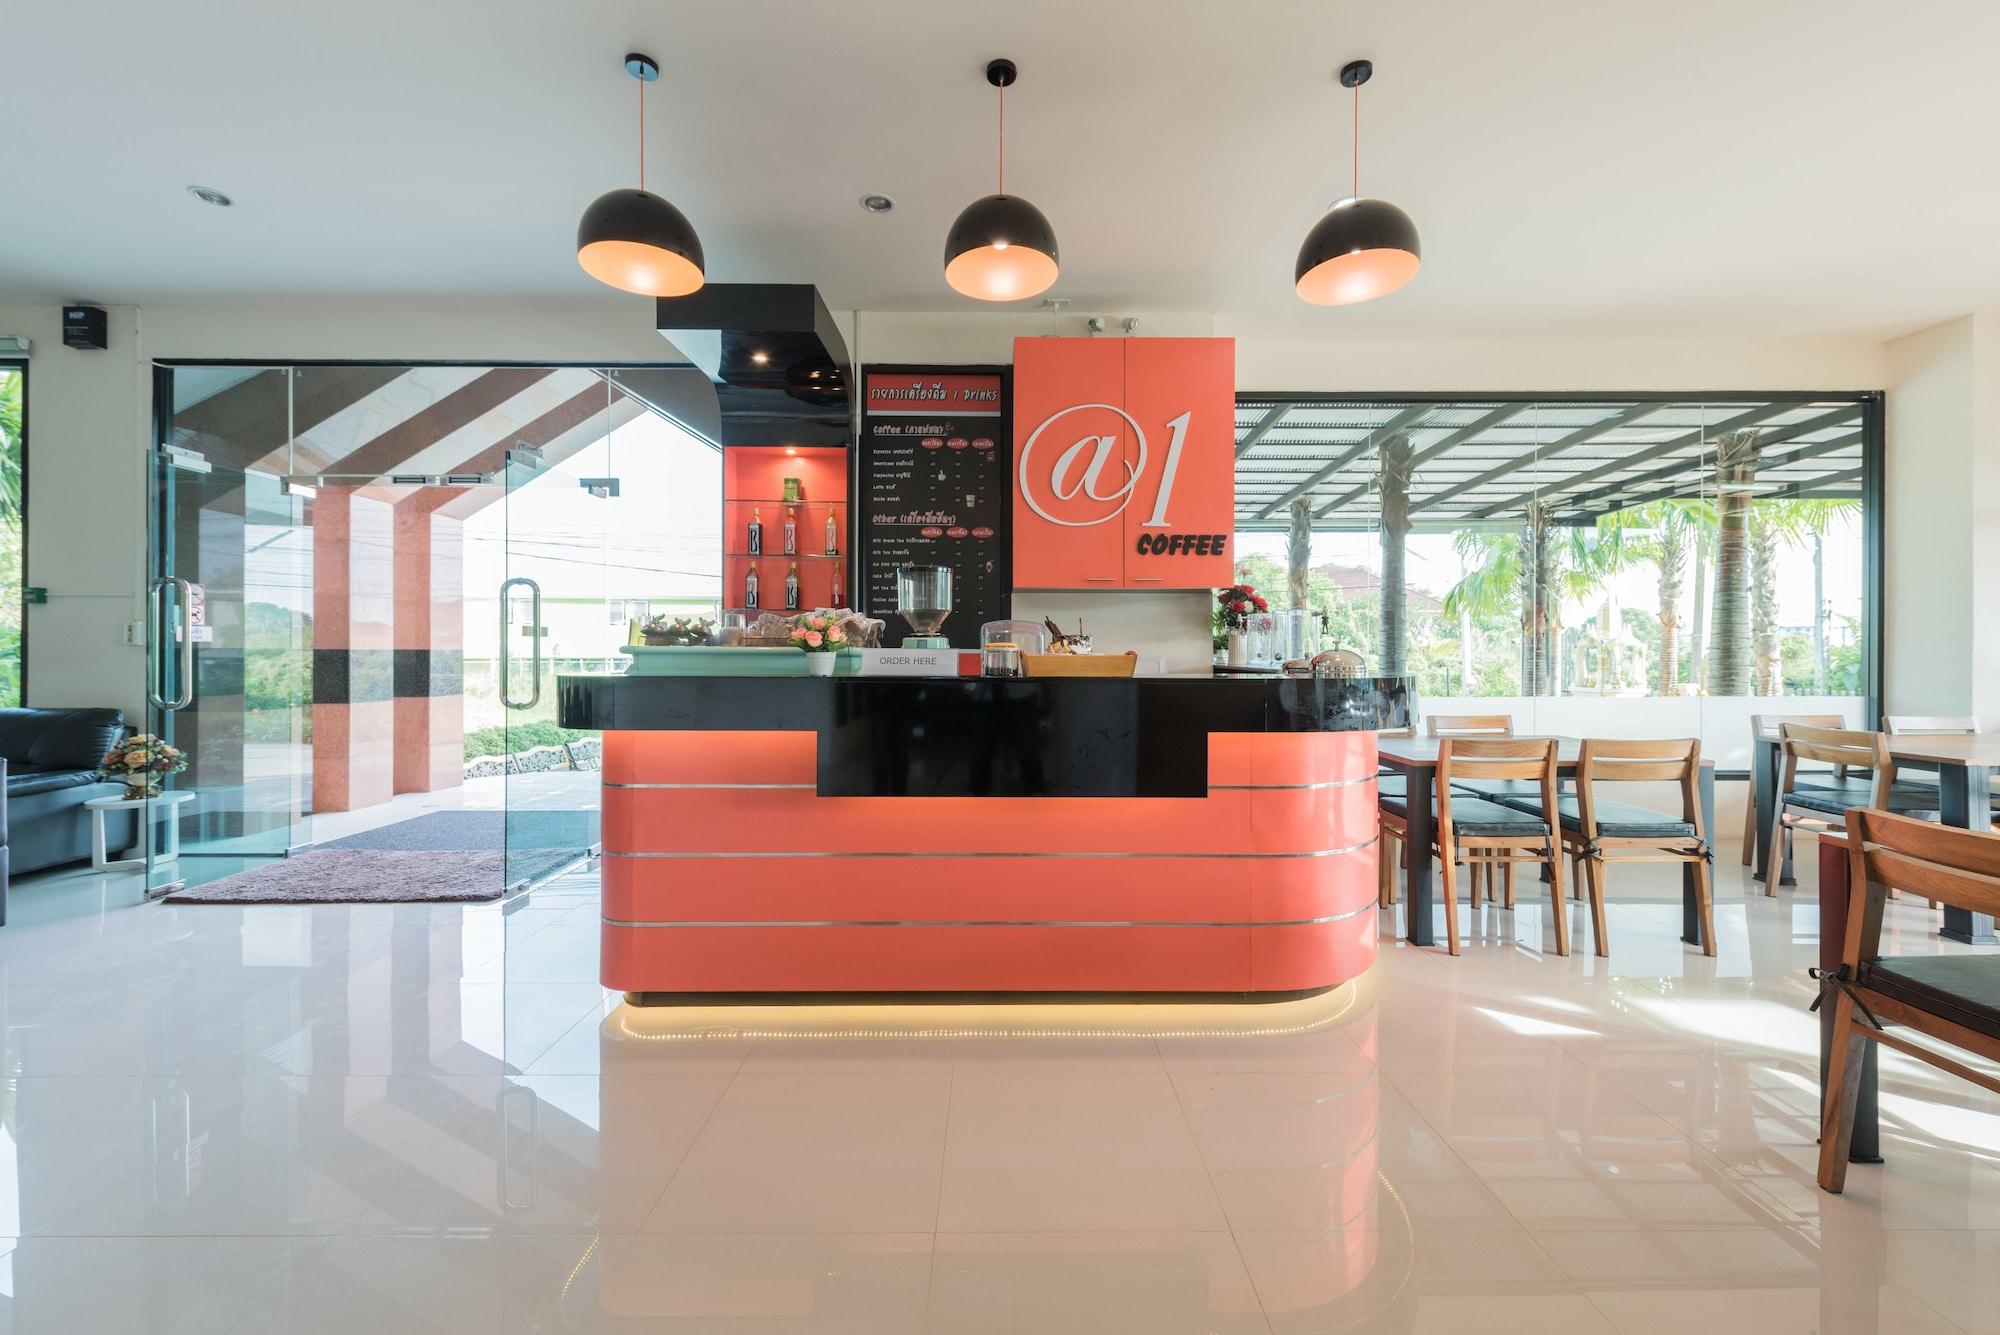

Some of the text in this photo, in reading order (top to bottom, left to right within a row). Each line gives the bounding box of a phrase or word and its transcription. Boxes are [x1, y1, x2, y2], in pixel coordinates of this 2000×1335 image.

[964, 389, 997, 401] Drinks
[872, 424, 902, 434] Coffee
[872, 513, 897, 523] Other
[1137, 533, 1227, 555] COFFEE
[880, 656, 937, 665] ORDER HERE
